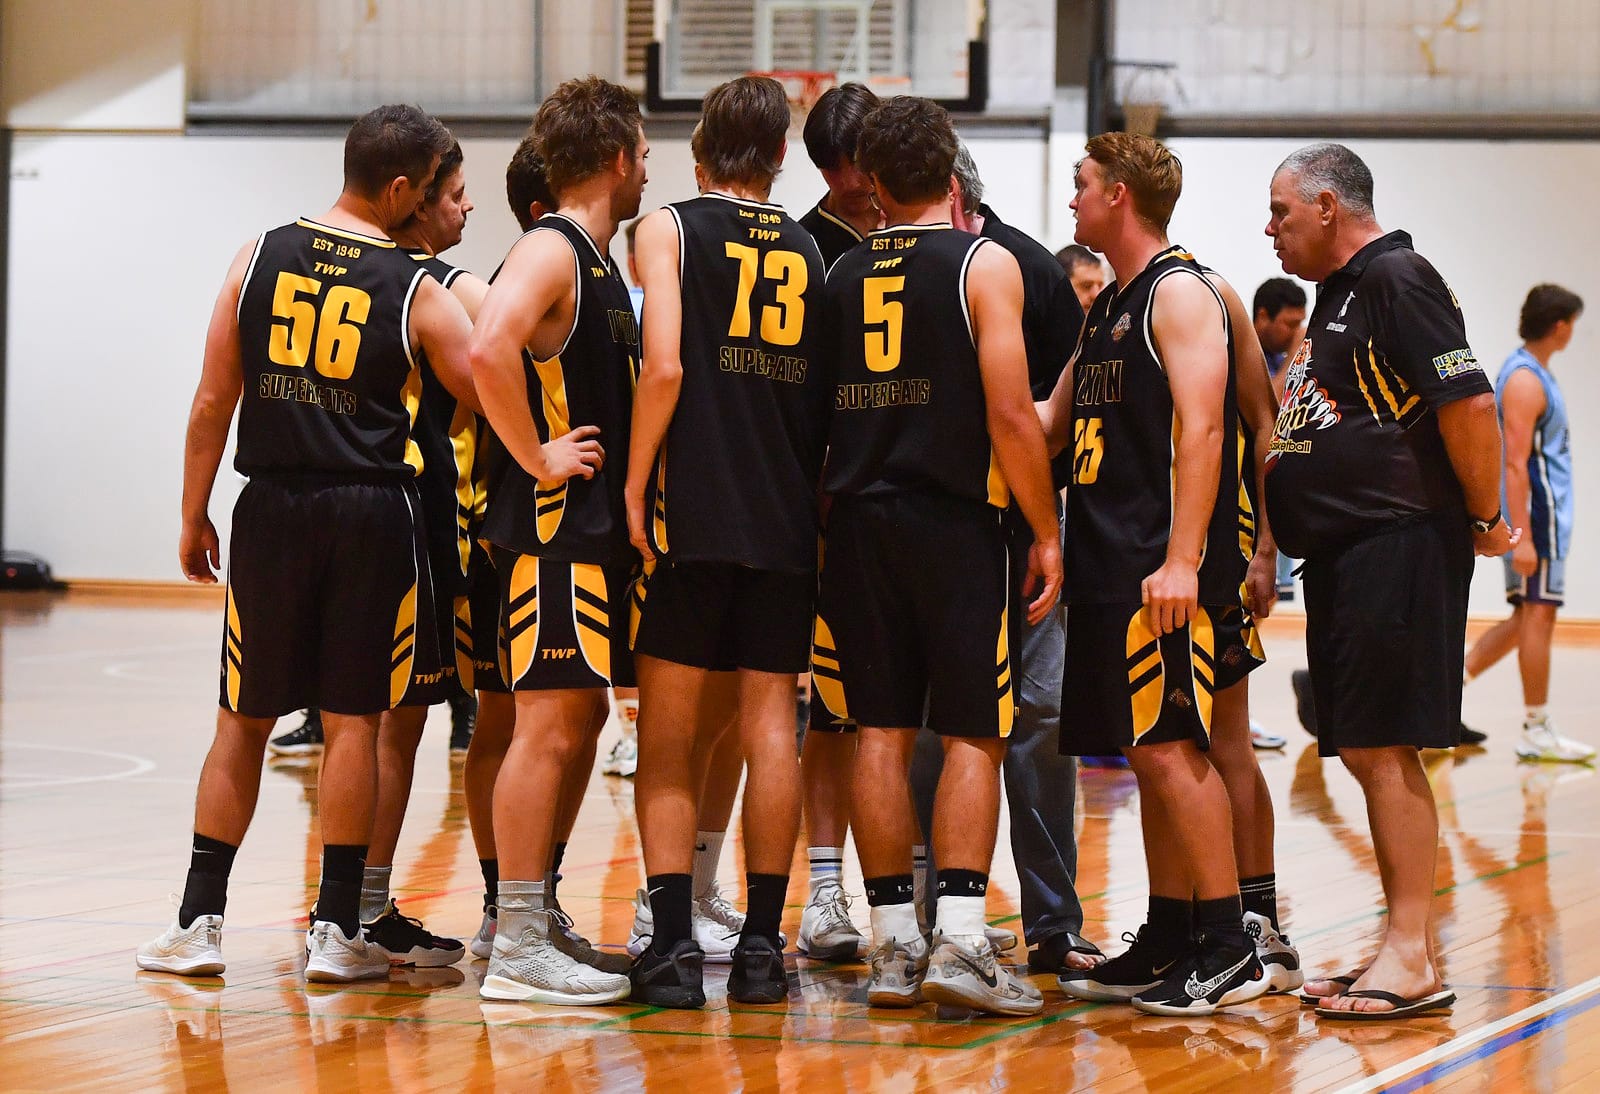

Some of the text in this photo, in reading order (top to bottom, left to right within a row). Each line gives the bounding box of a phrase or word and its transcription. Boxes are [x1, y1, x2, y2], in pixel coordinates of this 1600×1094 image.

[758, 213, 782, 224] 1949
[748, 228, 781, 242] TWP
[872, 237, 917, 250] EST 1949
[312, 237, 361, 259] EST 1949
[313, 261, 348, 277] TWP
[872, 256, 903, 271] TWP
[725, 241, 808, 346] 73
[268, 271, 371, 380] 56
[863, 275, 906, 373] 5
[1433, 349, 1473, 367] NETWOR
[259, 373, 358, 416] SUPERCATS
[835, 379, 931, 411] SUPERCATS
[541, 648, 576, 660] TWP
[415, 672, 441, 685] TWP
